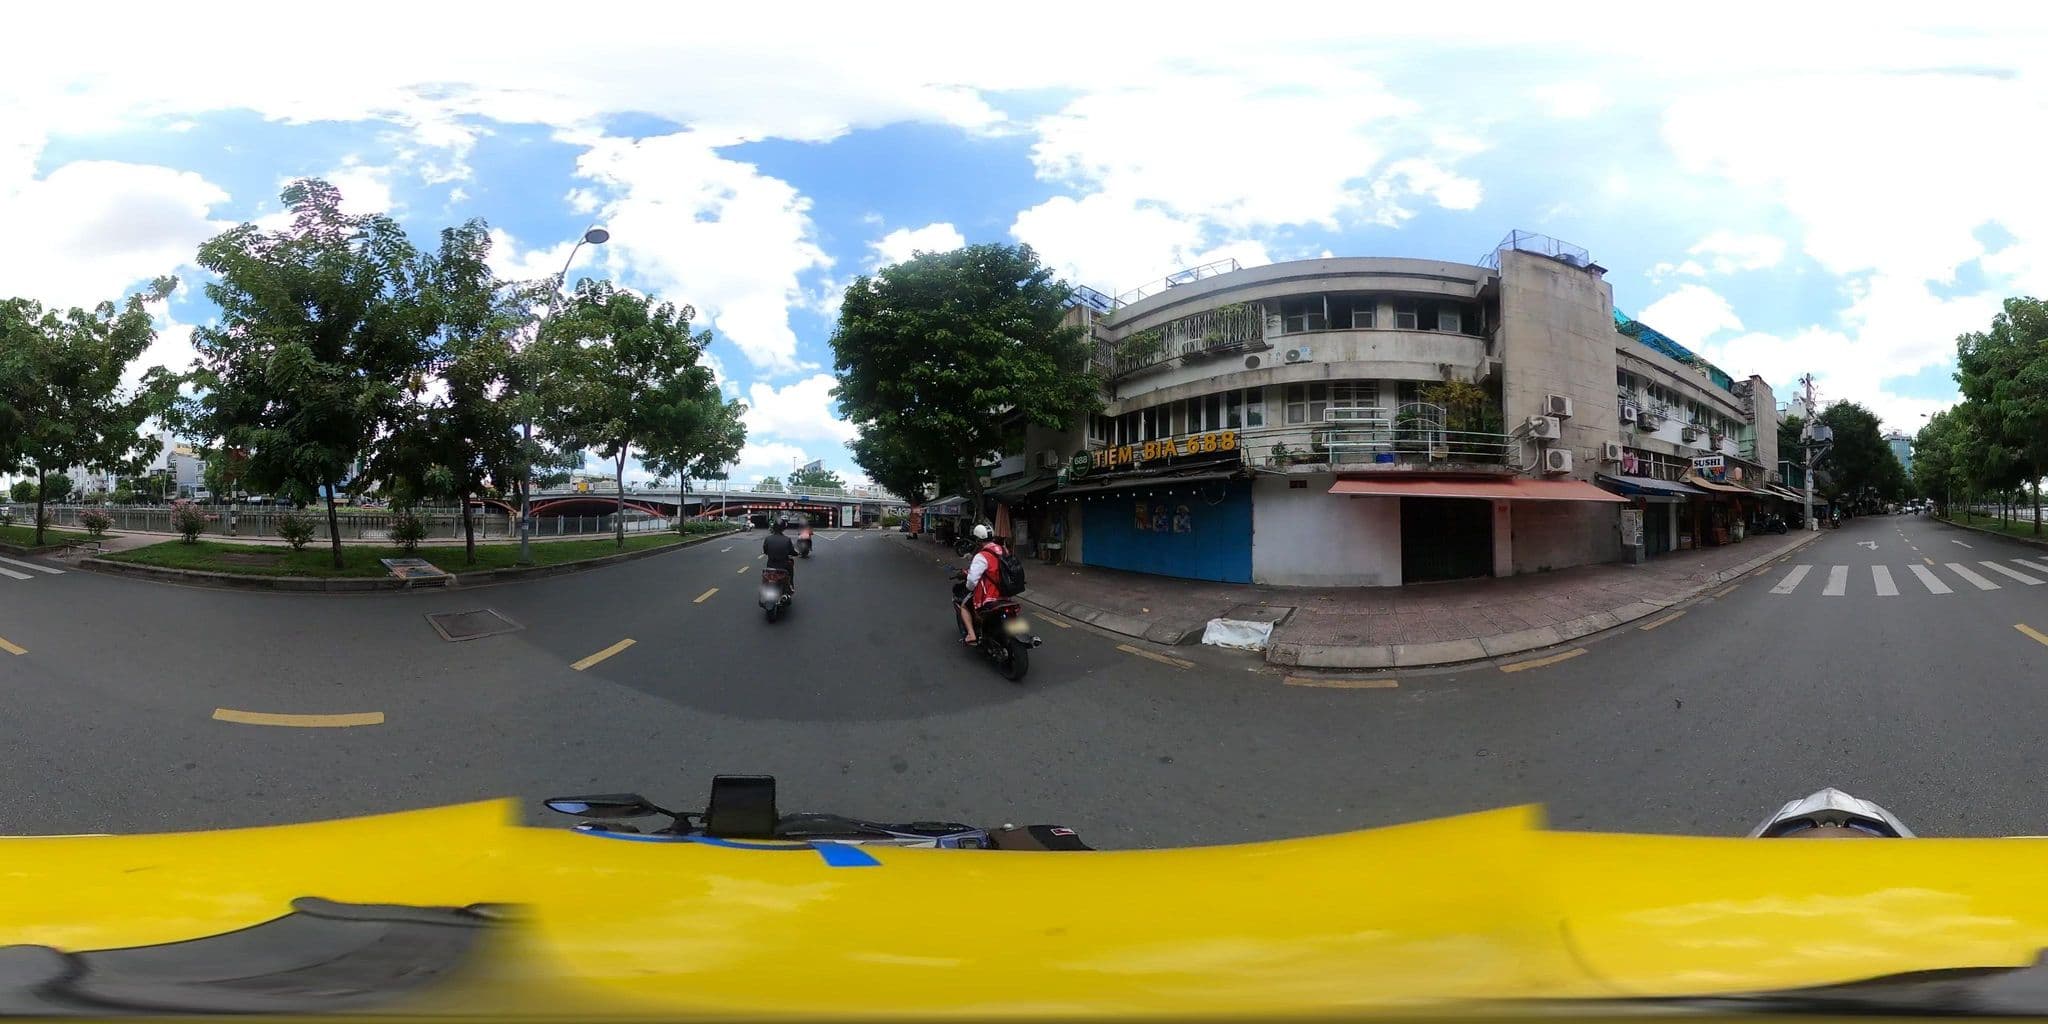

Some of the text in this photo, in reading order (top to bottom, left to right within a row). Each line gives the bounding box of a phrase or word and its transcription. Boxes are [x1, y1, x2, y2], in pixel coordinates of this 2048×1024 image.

[1143, 437, 1178, 461] BIA
[1187, 431, 1235, 455] 688
[1074, 454, 1088, 465] 688
[1694, 458, 1721, 467] SUSHI
